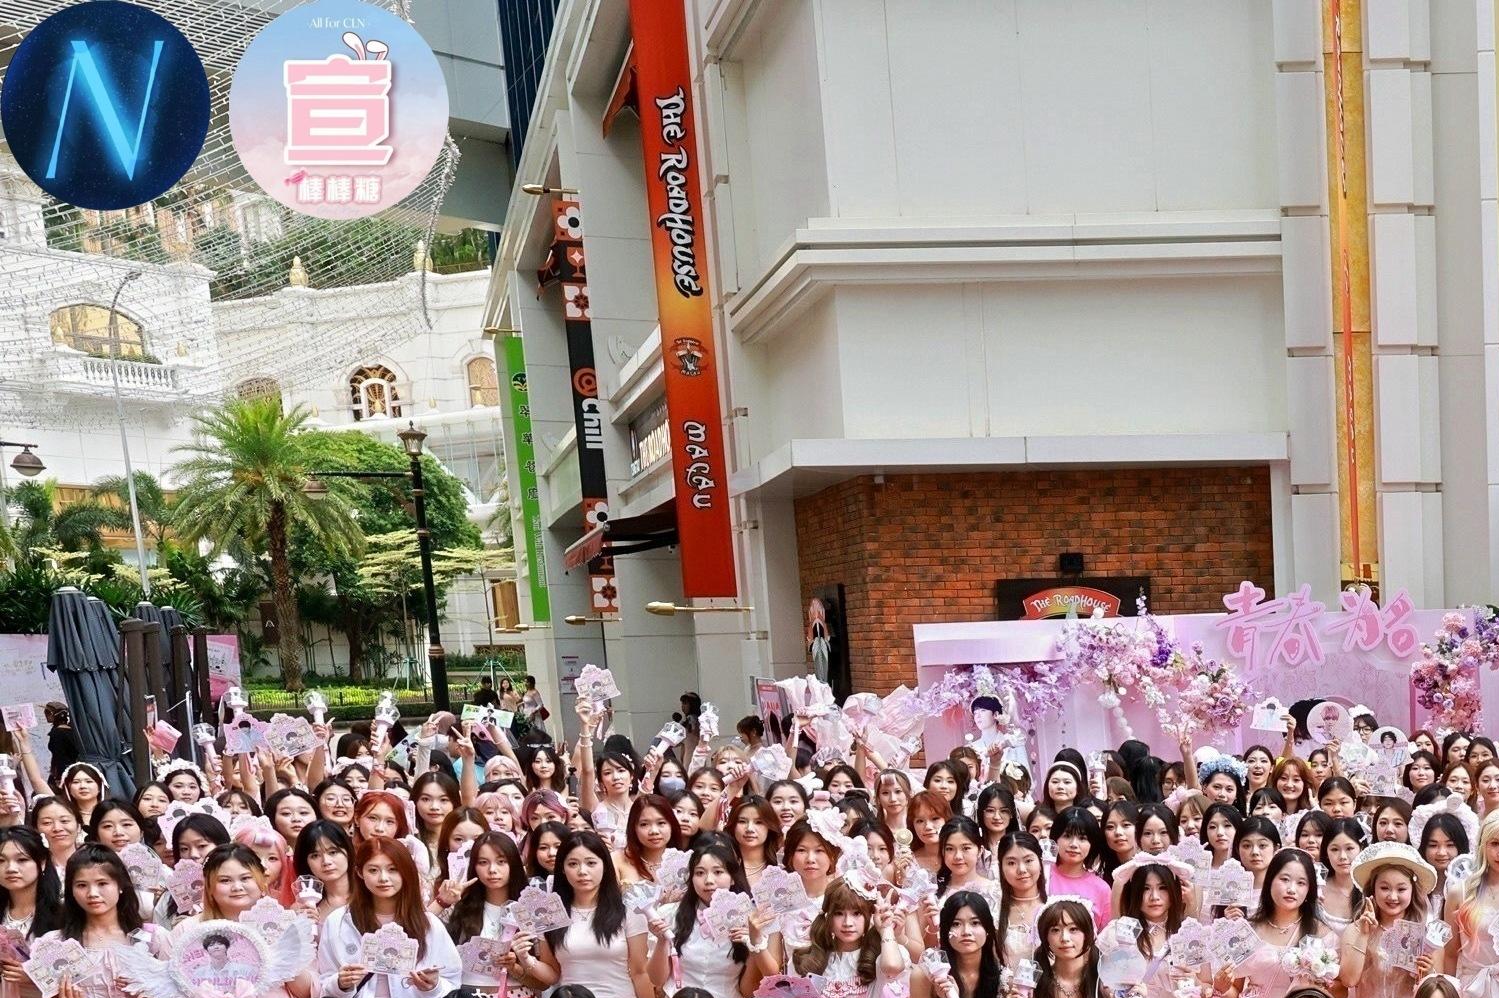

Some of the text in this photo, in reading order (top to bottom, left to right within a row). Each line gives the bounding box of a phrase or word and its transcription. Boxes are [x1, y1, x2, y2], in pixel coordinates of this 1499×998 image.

[682, 420, 716, 509] MACAU
[1030, 594, 1112, 613] THE ROADHOUSE
